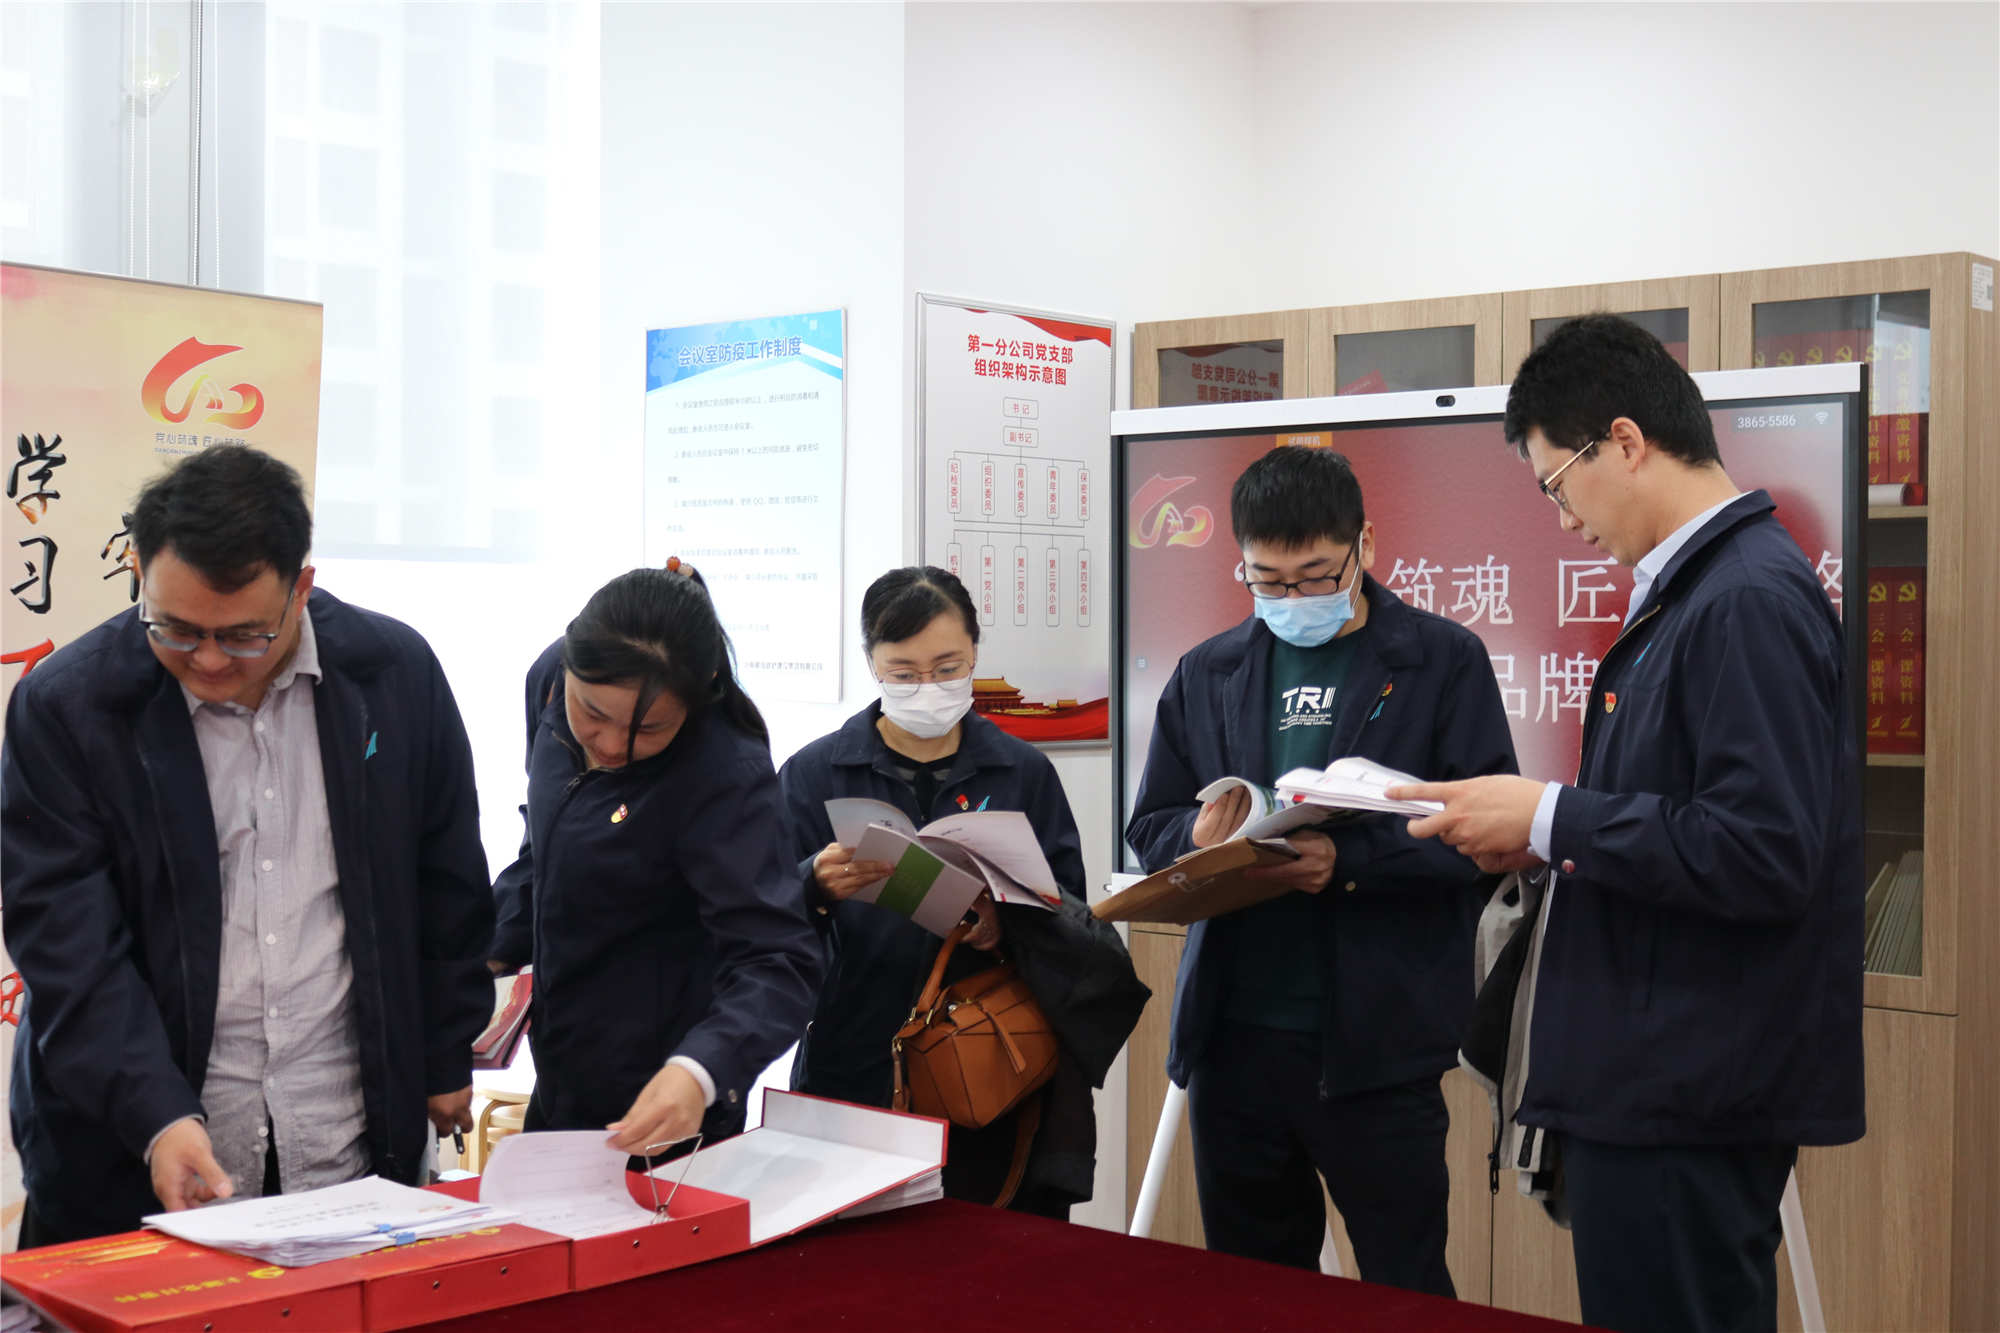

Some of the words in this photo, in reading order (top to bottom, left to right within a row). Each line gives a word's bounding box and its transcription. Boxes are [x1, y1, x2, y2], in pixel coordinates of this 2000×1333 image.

[679, 336, 803, 366] 会议室防疫工作制度
[967, 334, 1074, 365] 第一分公司党支部
[974, 358, 1067, 386] 组织架构示意图
[1737, 414, 1797, 429] 3865-5586
[7, 432, 67, 615] 学习
